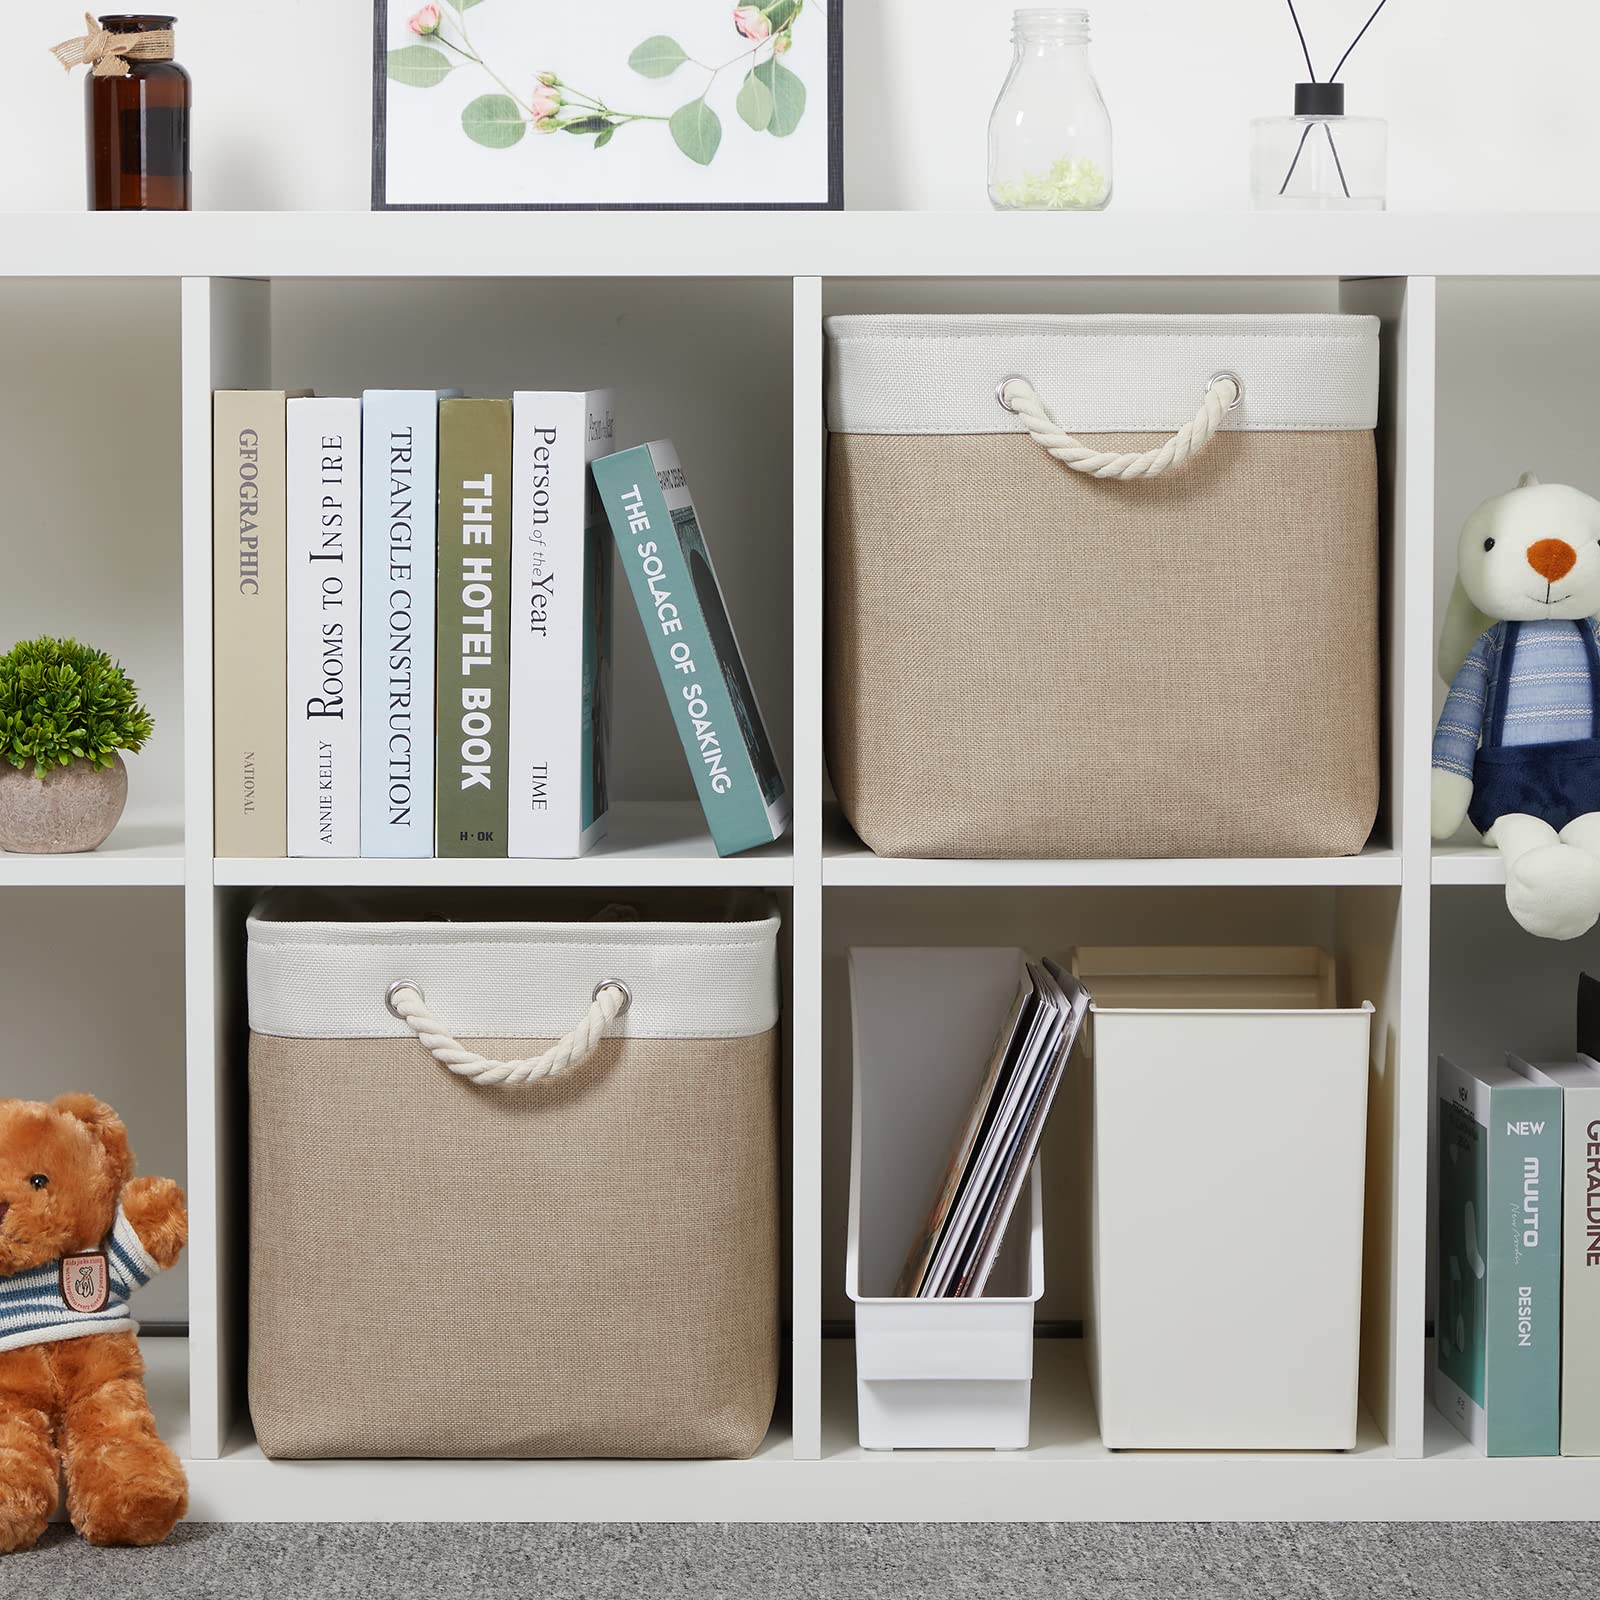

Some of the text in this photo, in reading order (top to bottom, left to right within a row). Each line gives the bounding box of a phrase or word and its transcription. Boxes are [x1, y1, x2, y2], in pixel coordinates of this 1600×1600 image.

[528, 425, 557, 638] Person of the Year
[321, 576, 344, 611] TO
[388, 426, 413, 828] TRIANGLE CONSTRUCTION
[460, 473, 493, 791] THE HOTEL BOOK
[620, 483, 732, 794] THE SOLACE OF SOAKING
[306, 623, 344, 721] ROOMS
[243, 751, 255, 816] NATIONAL
[319, 740, 333, 845] ANNIE KELLY
[531, 761, 548, 811] TIME
[1506, 1121, 1546, 1136] NEW
[1586, 1120, 1600, 1267] GERALDINE
[1517, 1286, 1532, 1347] DESIGN
